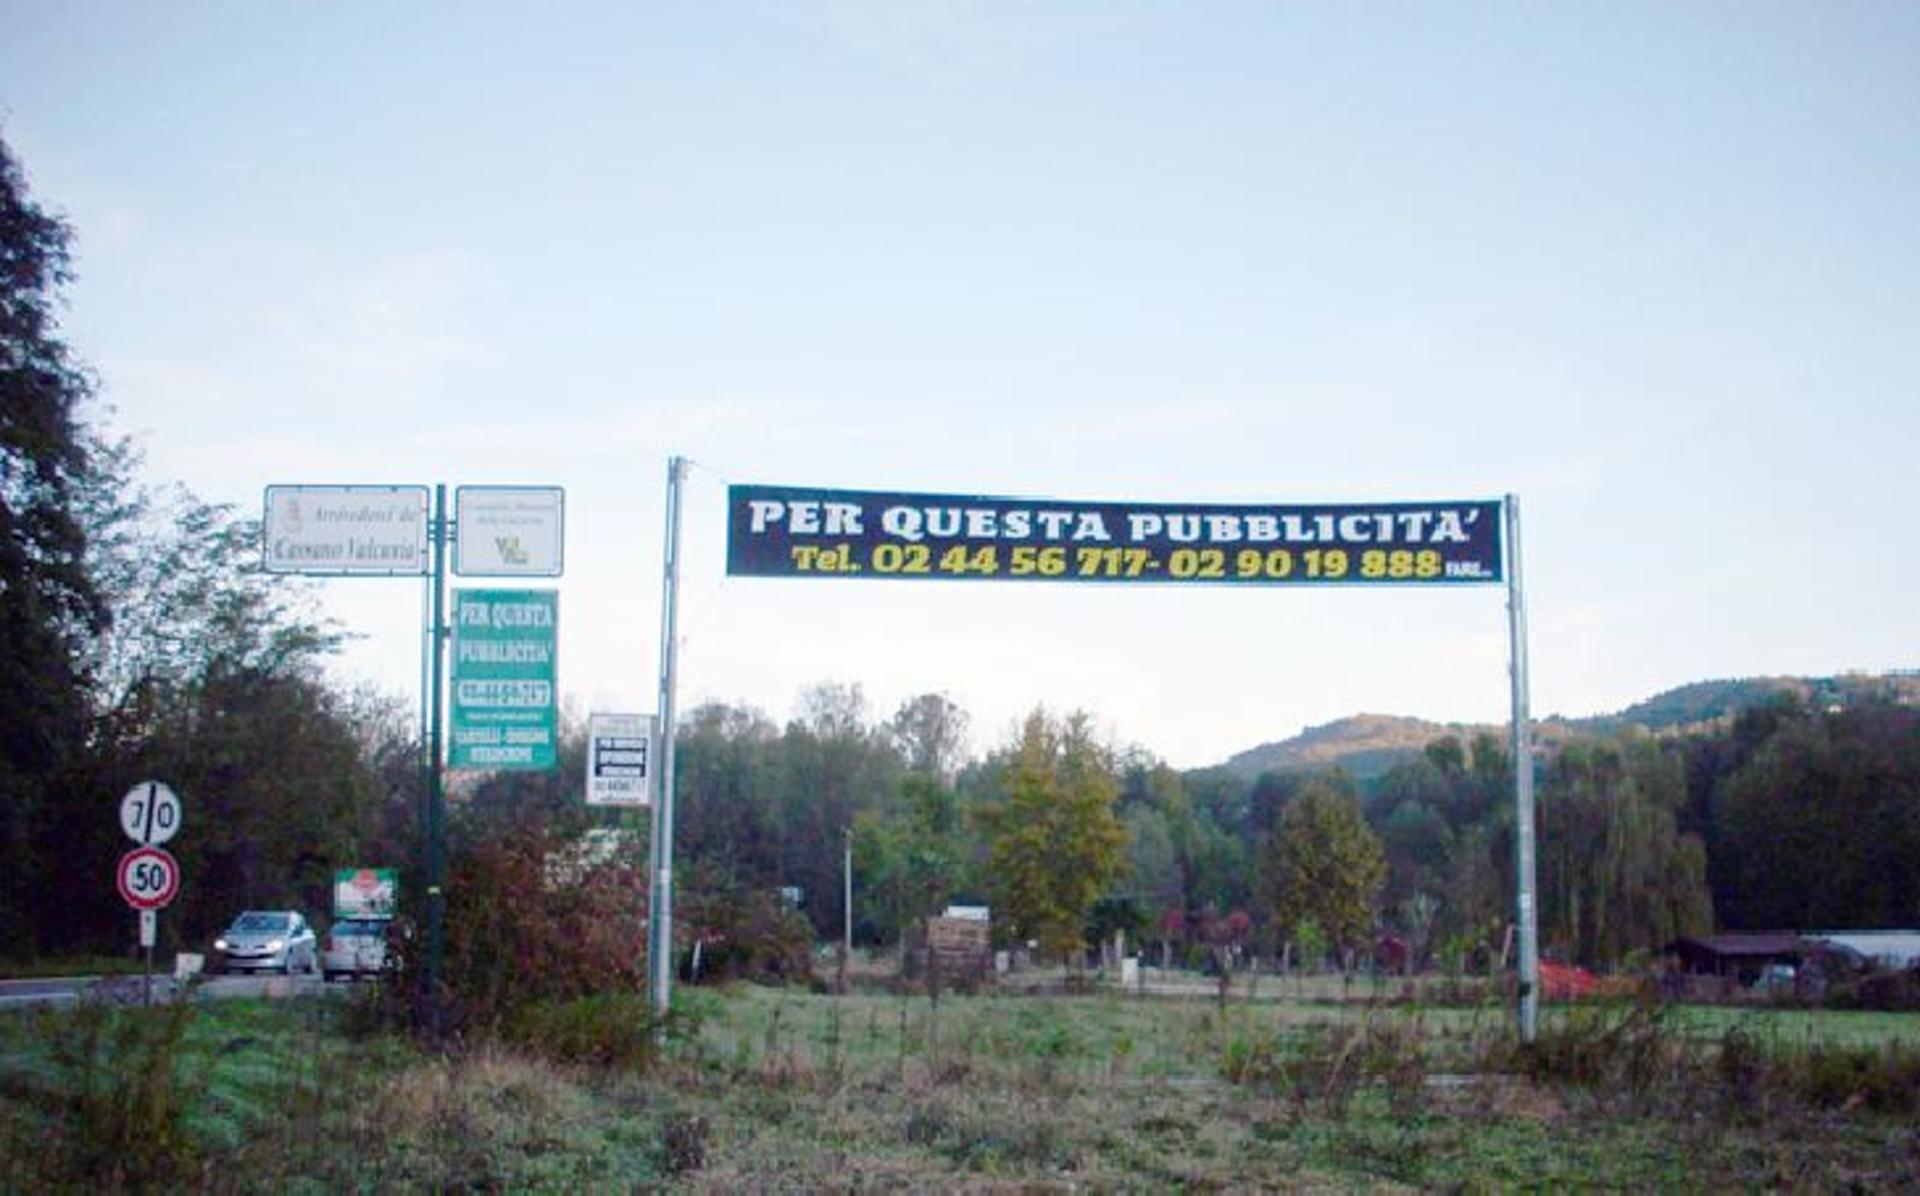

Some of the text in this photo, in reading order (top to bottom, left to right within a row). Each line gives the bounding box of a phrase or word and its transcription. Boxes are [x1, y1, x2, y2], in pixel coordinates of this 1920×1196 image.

[748, 501, 864, 534] PER
[881, 505, 1111, 541] QUESTA
[791, 544, 862, 572] Tel.
[871, 544, 931, 574] 02
[939, 545, 999, 574] 44
[1009, 546, 1066, 575] 56
[1169, 548, 1226, 577] 02
[1236, 548, 1292, 577] 90
[1303, 549, 1349, 577] 19
[1360, 548, 1442, 578] 888
[134, 863, 163, 892] 50
